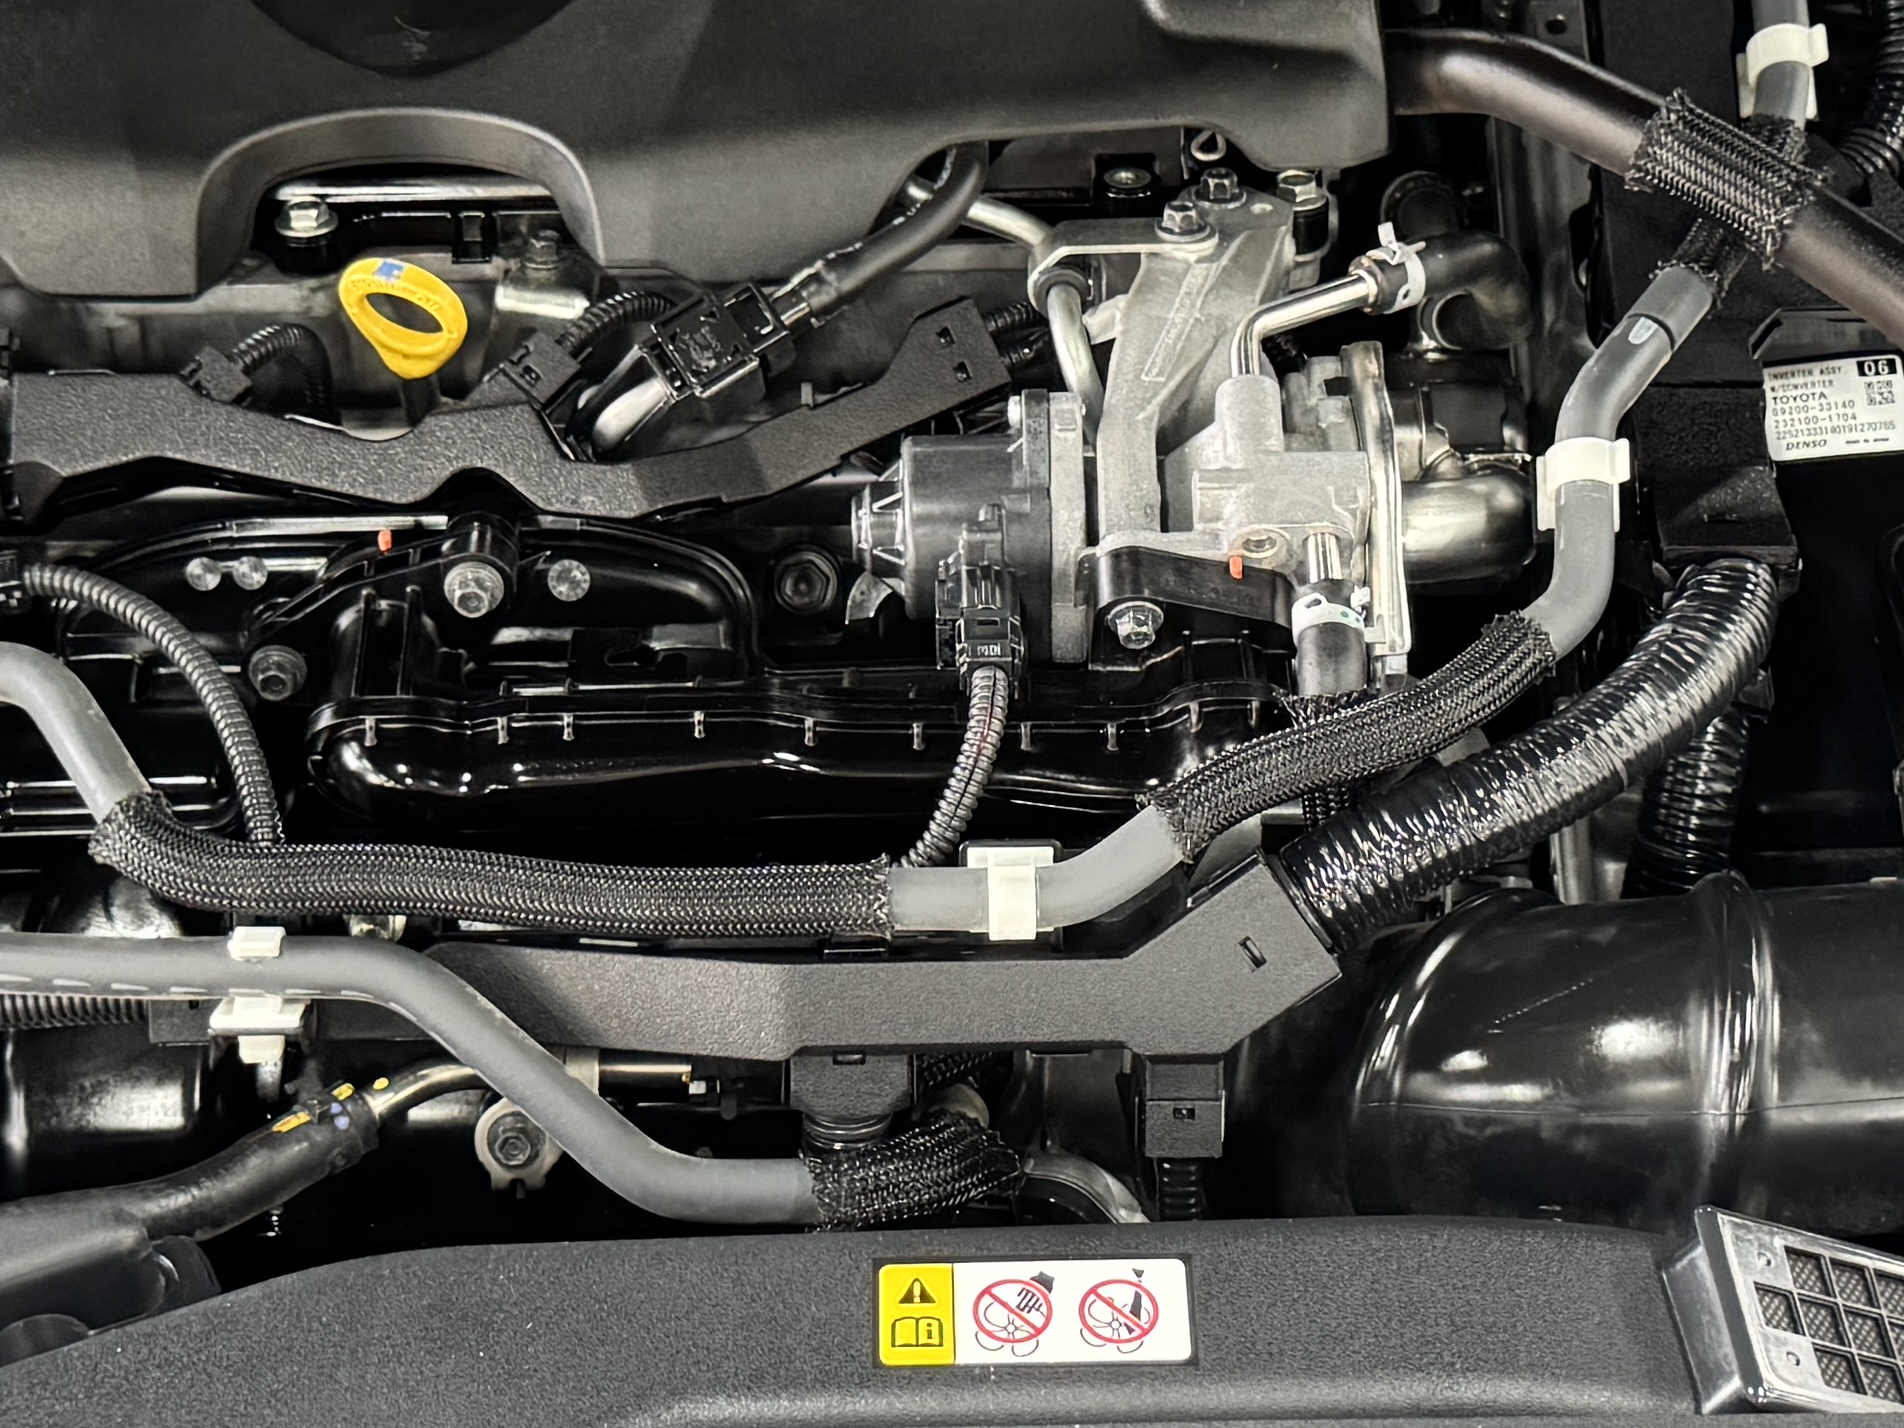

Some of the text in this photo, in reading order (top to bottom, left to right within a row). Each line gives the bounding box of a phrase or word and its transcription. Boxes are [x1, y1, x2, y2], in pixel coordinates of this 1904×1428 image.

[1863, 359, 1889, 376] 06
[1768, 369, 1814, 382] INVERTER
[1772, 391, 1828, 406] TOYOTA
[1786, 439, 1827, 451] DENSO
